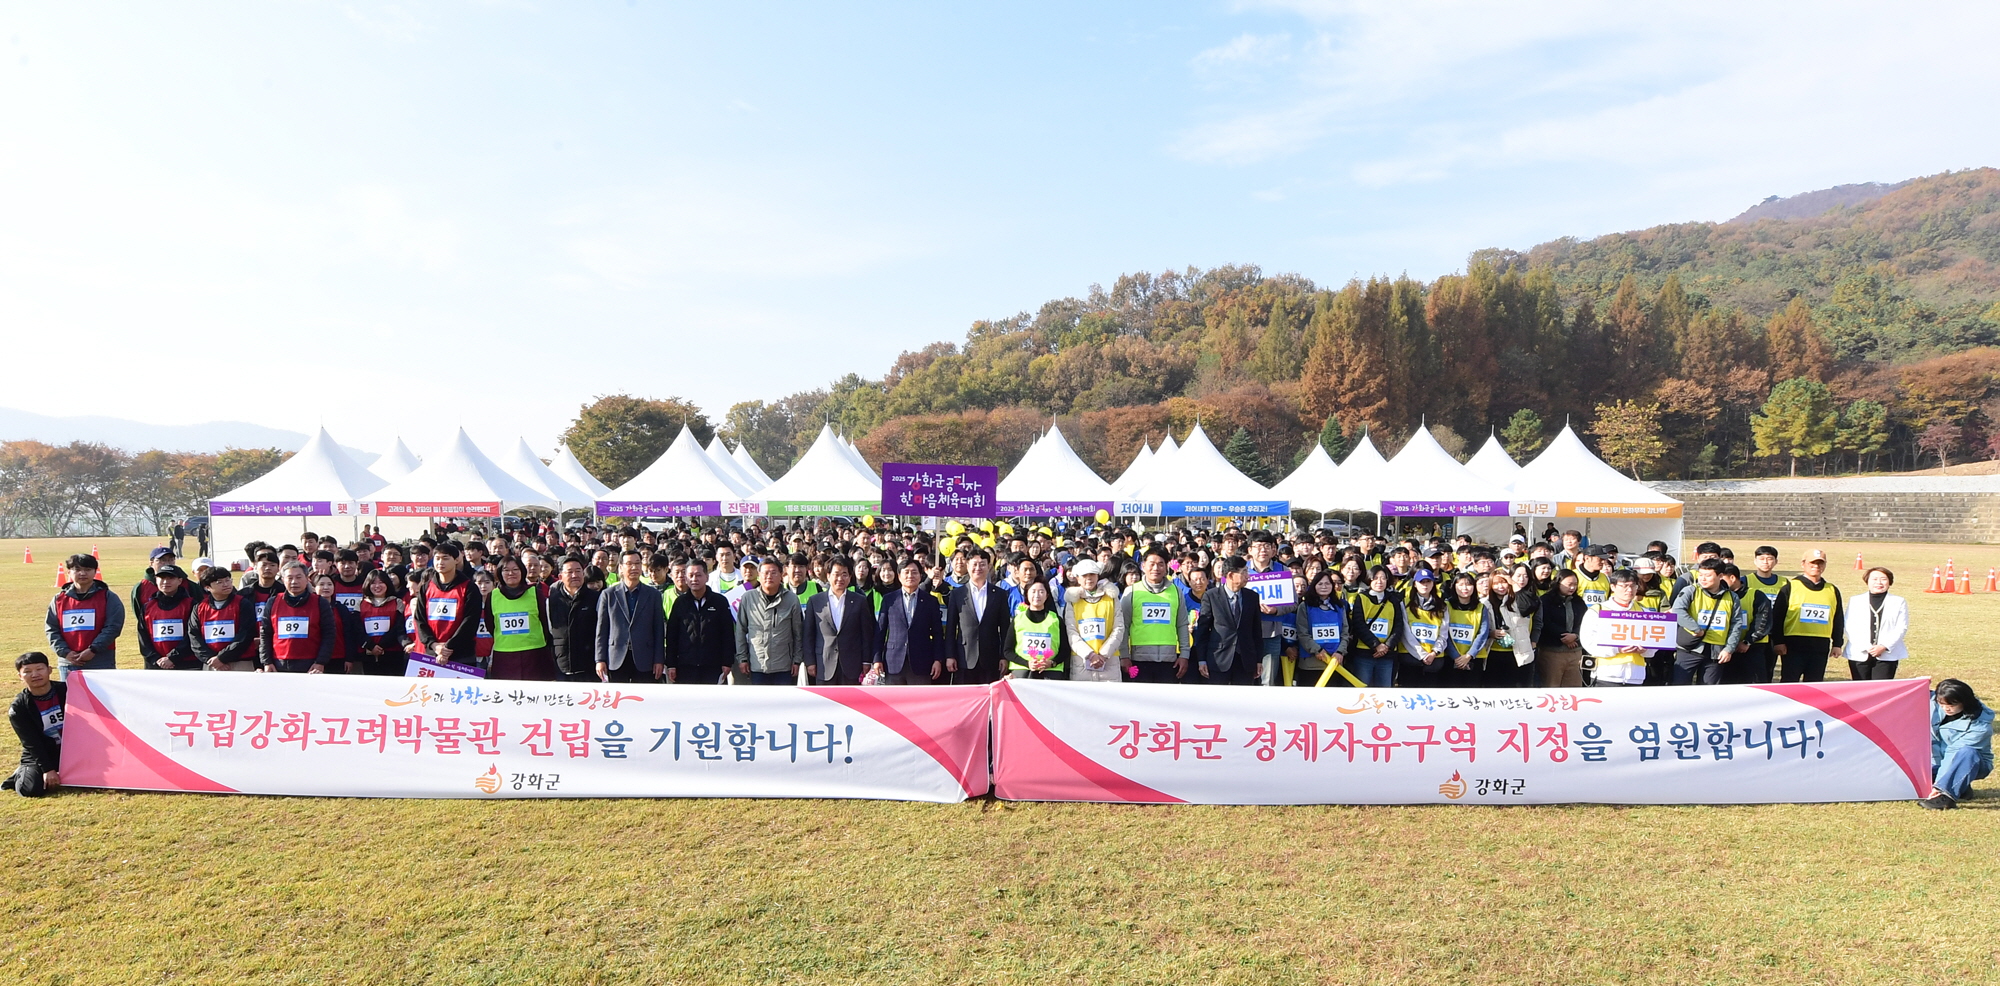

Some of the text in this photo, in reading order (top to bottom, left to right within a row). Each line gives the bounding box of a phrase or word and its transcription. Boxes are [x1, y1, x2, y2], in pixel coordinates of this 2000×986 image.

[907, 472, 982, 493] 강화군공직자
[899, 491, 985, 509] 한마음체육대회
[728, 502, 760, 514] 진달래
[1121, 503, 1154, 514] 저어새
[1228, 505, 1246, 513] 우승은
[1517, 503, 1549, 515] 감나무
[344, 598, 356, 607] 40
[1587, 594, 1603, 603] 806
[436, 605, 448, 614] 66
[1146, 608, 1167, 618] 297
[1805, 609, 1825, 619] 792
[71, 615, 85, 625] 26
[504, 619, 525, 629] 309
[160, 625, 174, 635] 25
[285, 622, 300, 632] 89
[373, 622, 379, 631] 3
[1083, 623, 1101, 635] 821
[212, 627, 226, 637] 24
[1317, 628, 1335, 638] 535
[1415, 628, 1433, 639] 839
[1452, 629, 1470, 639] 759
[1611, 623, 1666, 643] 감나무
[1027, 639, 1047, 649] 296
[384, 683, 445, 707] 소통과
[508, 689, 539, 706] 함께
[542, 694, 575, 707] 만드는
[577, 688, 645, 710] 강화
[1336, 693, 1399, 715] 소통과
[1462, 696, 1496, 711] 함께
[1501, 697, 1533, 711] 만드는
[1536, 693, 1603, 713] 강화
[49, 711, 64, 724] 85
[165, 709, 855, 765] 국립강화고려박물관 건립을 기원합니다!
[1107, 720, 1825, 763] 강화군 경제자유구역 지정을 염원합니다!
[510, 773, 561, 791] 강화군
[1474, 778, 1527, 796] 강화군
